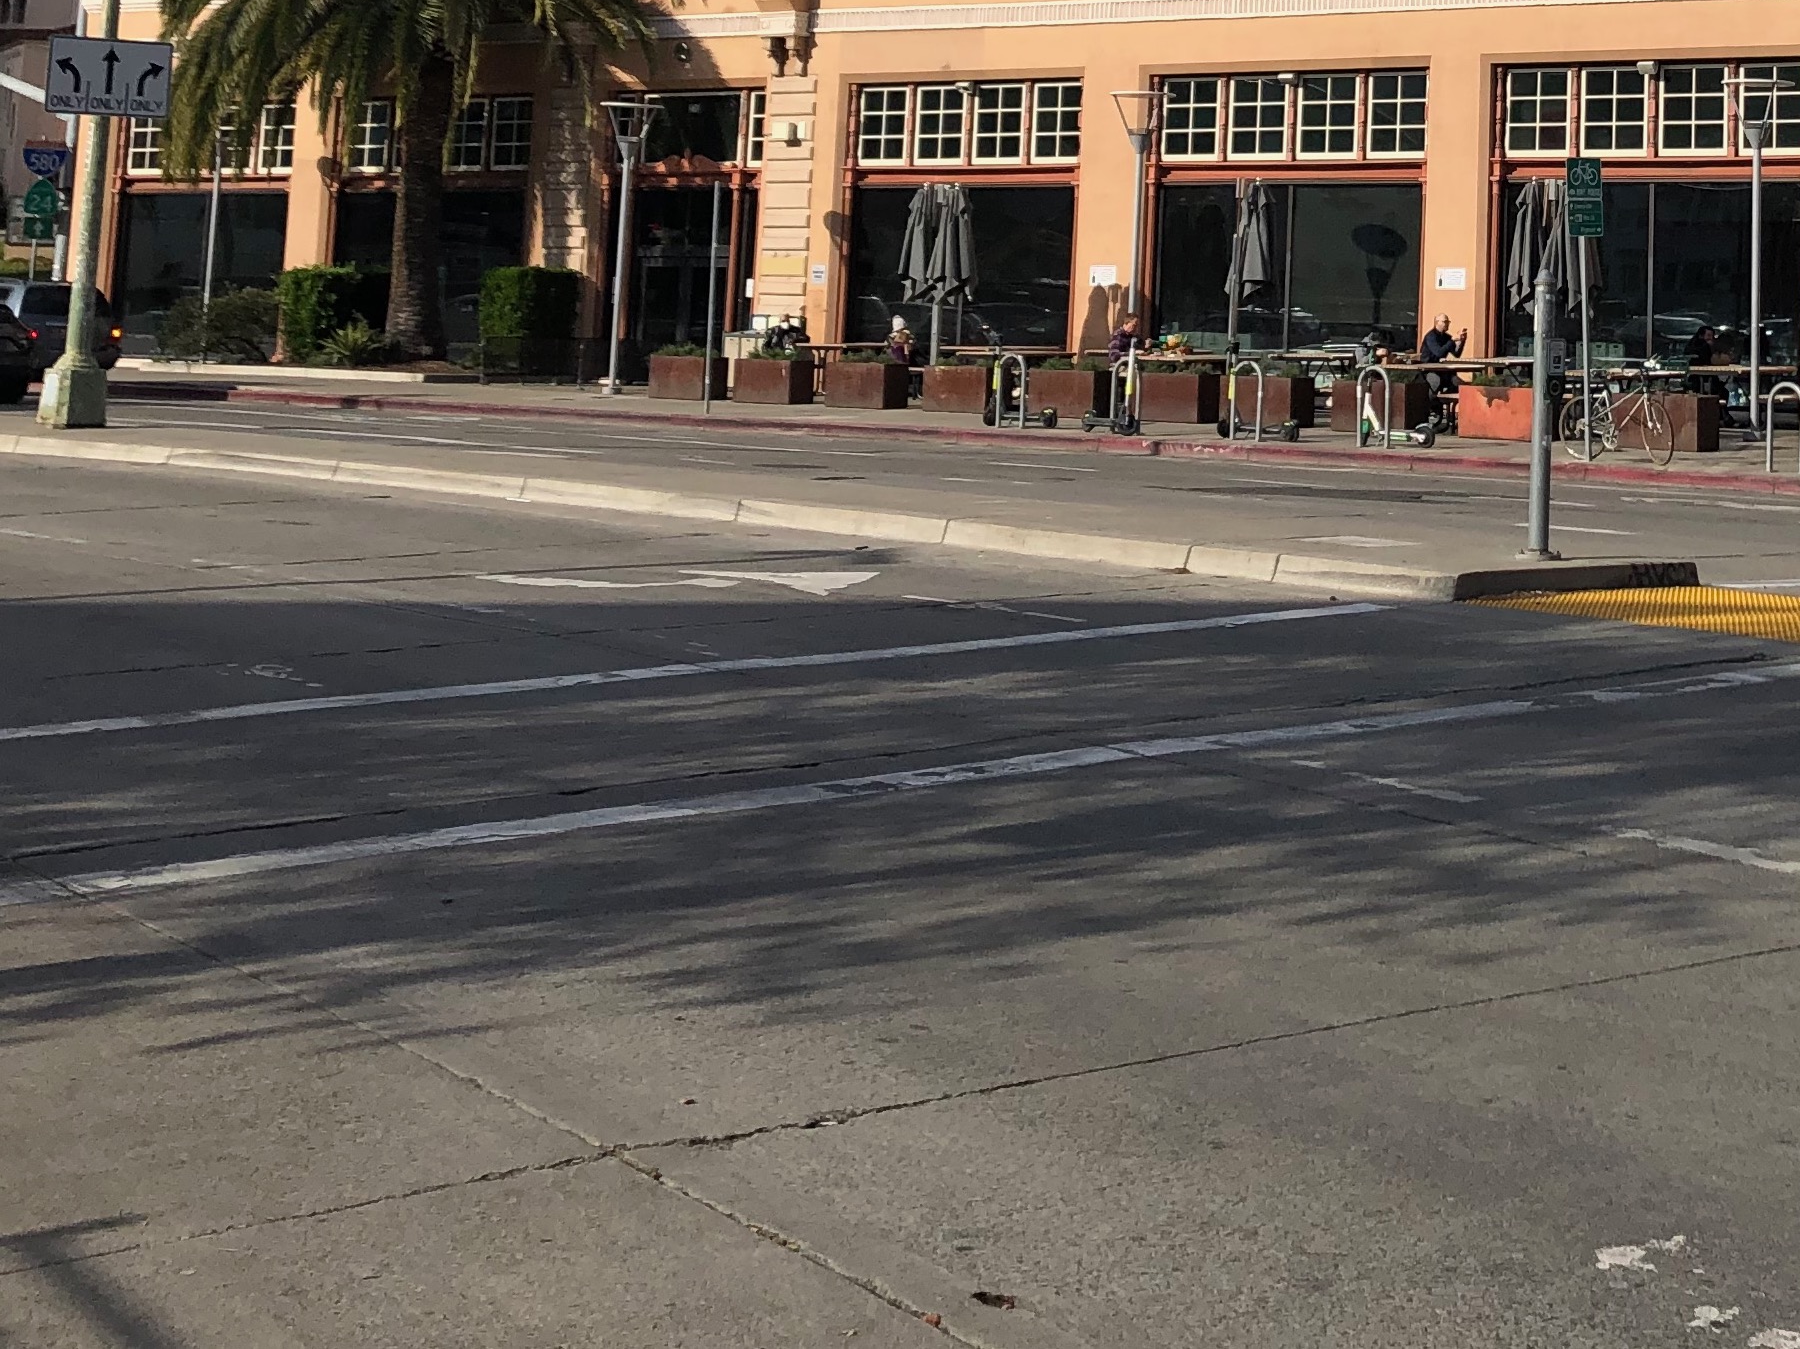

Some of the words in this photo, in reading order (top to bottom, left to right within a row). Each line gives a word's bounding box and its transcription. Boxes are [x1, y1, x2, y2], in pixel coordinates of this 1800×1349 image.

[50, 94, 85, 108] ONLY
[90, 97, 124, 110] ONLY
[130, 99, 163, 113] ONLY
[30, 153, 60, 170] 580
[29, 194, 53, 210] 24
